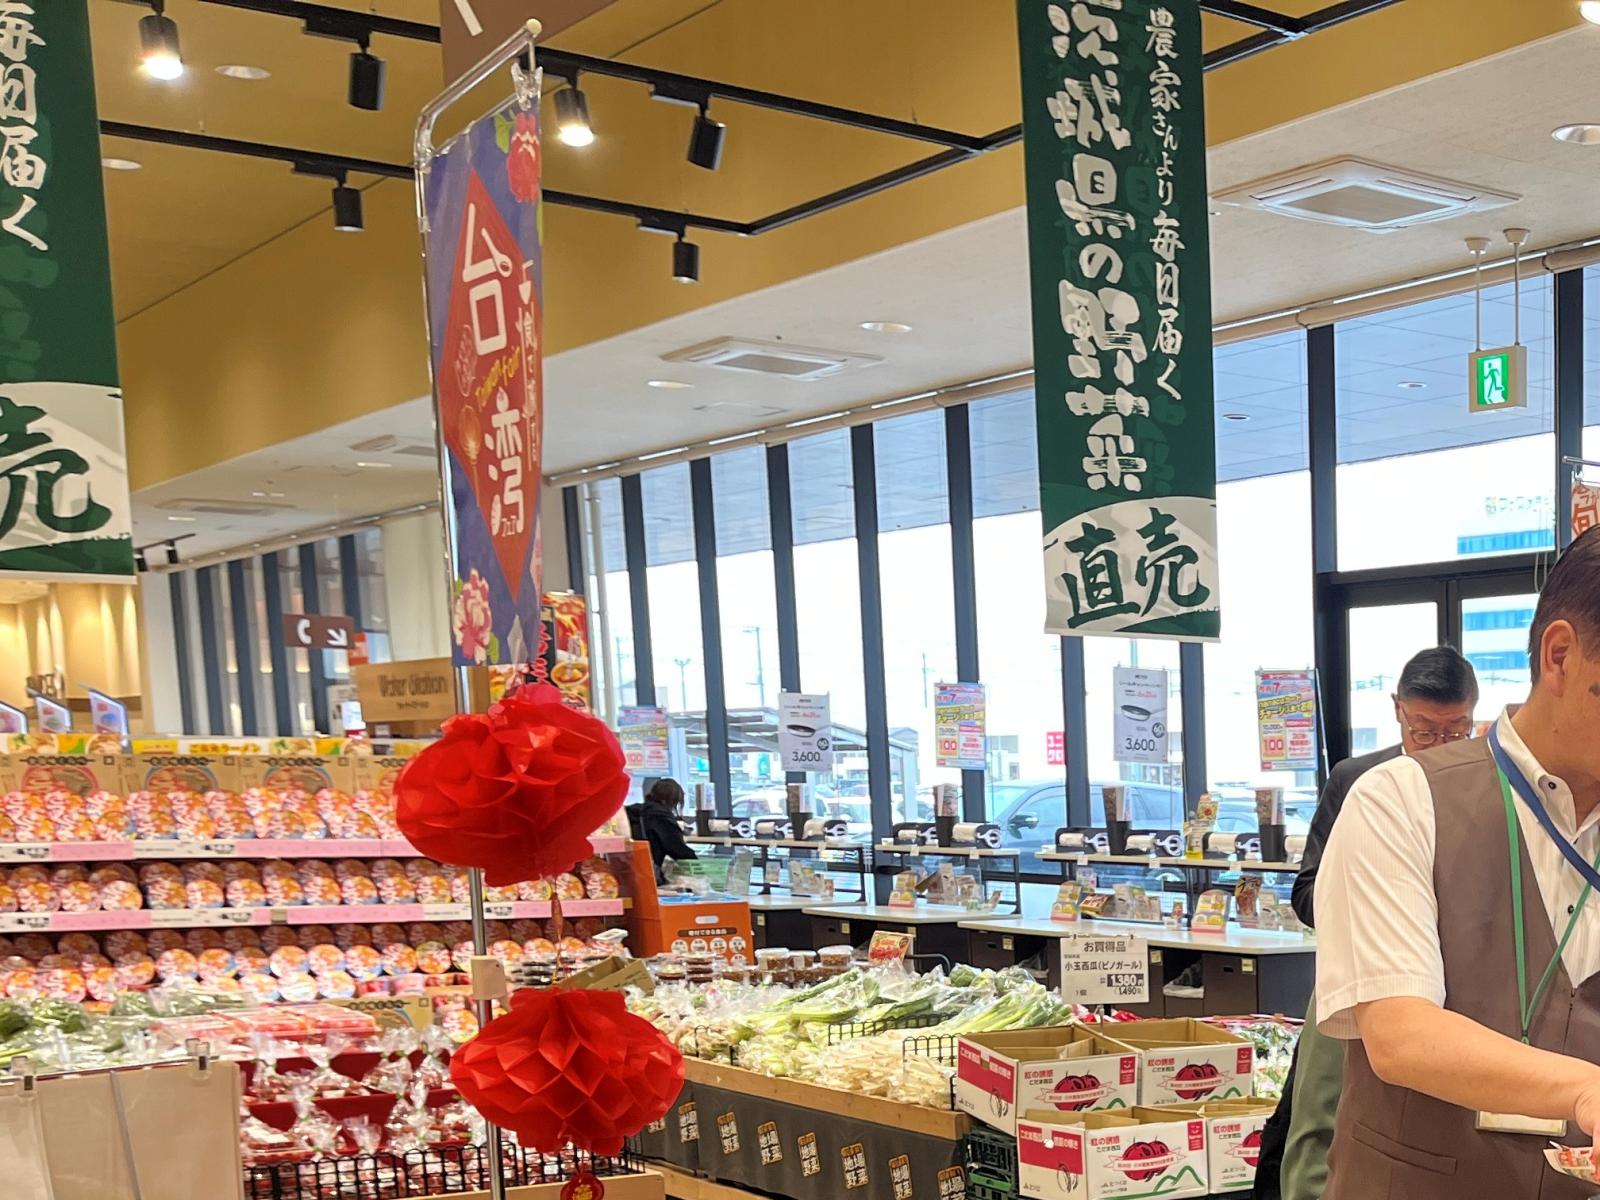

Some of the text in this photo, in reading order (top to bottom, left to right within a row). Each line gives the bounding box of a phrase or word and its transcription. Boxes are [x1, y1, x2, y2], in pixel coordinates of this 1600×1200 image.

[1146, 7, 1185, 401] 農家さんより毎日届く
[1060, 507, 1211, 630] 直売
[1064, 960, 1144, 972] 小玉西瓜(ピノガール)
[1083, 941, 1127, 953] お買得品
